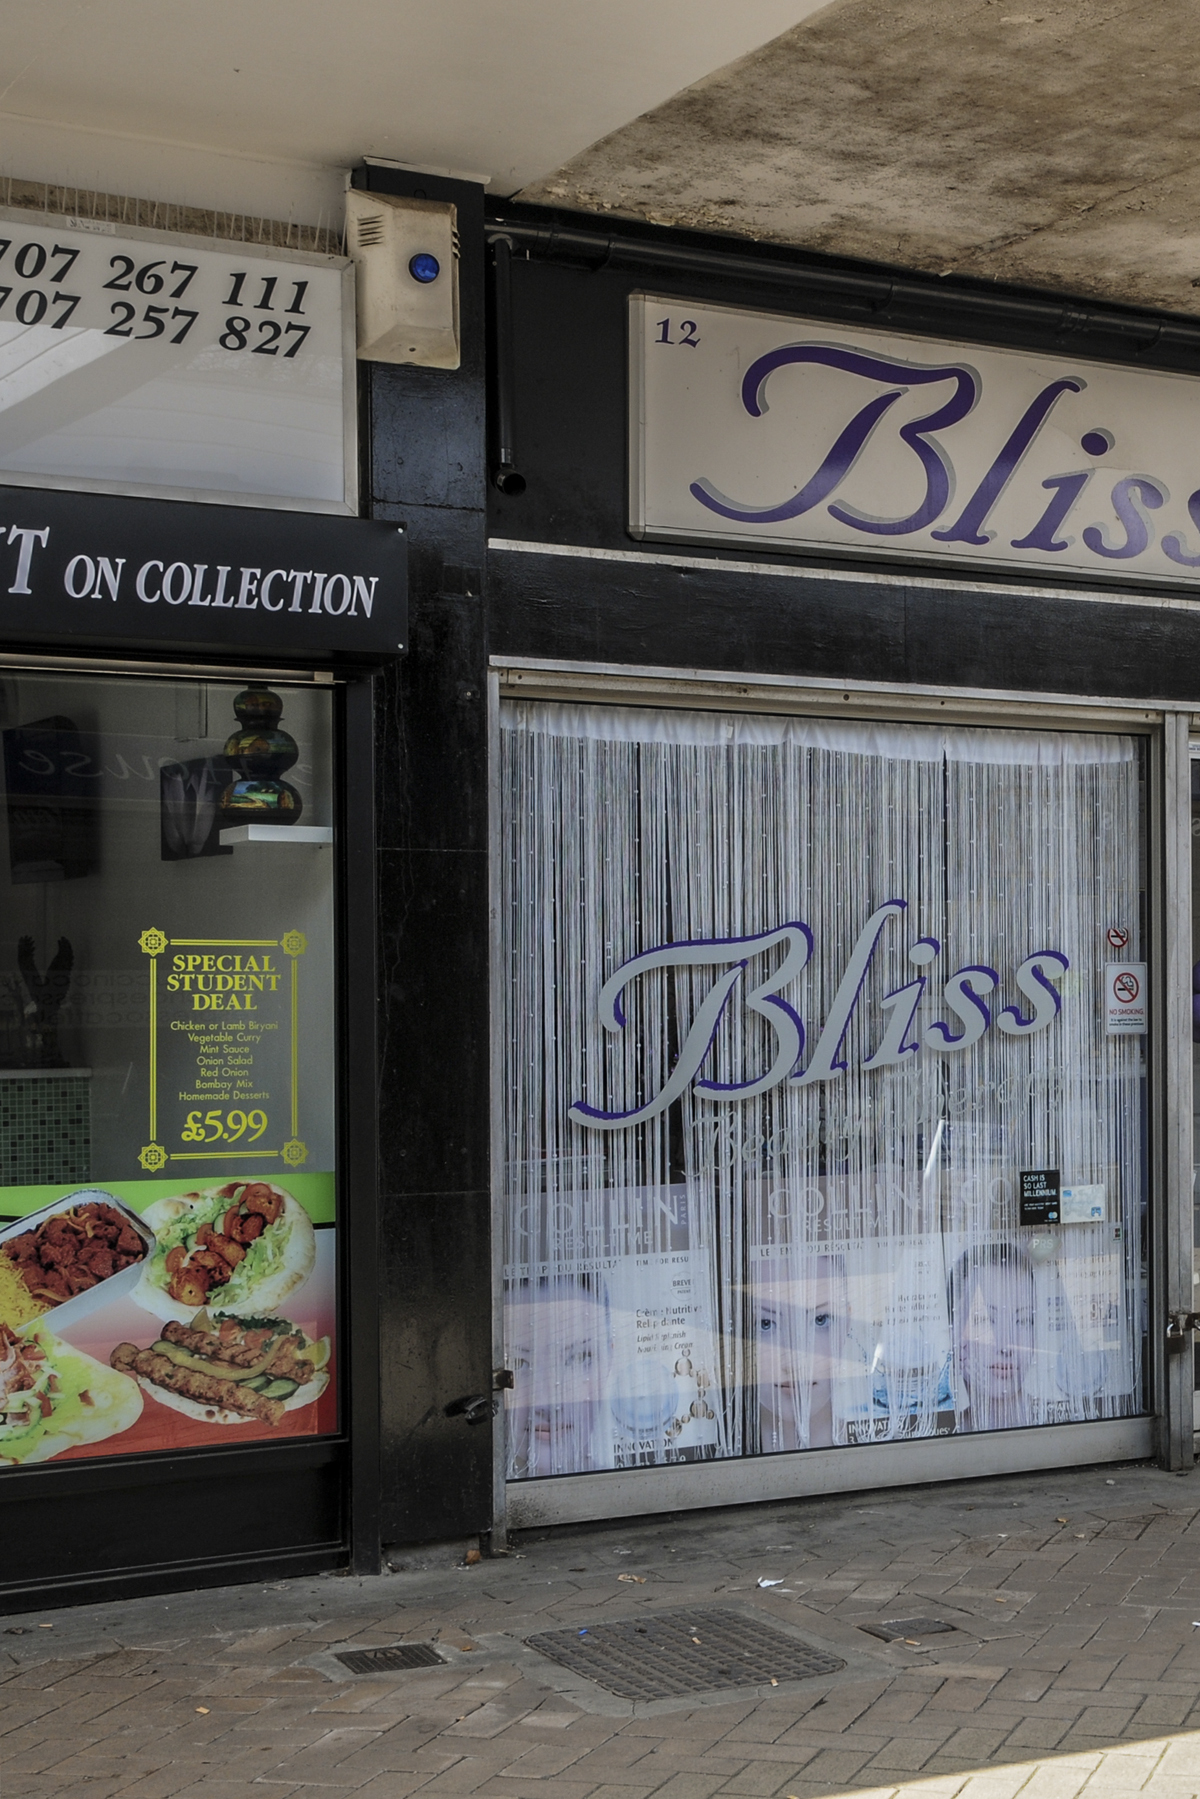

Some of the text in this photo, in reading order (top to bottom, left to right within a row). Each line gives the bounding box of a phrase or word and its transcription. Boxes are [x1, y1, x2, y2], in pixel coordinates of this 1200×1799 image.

[103, 256, 199, 299] 267
[222, 272, 310, 315] 111
[103, 301, 200, 345] 257
[218, 316, 312, 359] 827
[654, 317, 702, 349] 12
[0, 525, 380, 619] T ON COLLECTION
[172, 954, 276, 973] SPECIAL
[166, 973, 282, 992] STUDENT
[192, 993, 258, 1011] DEAL
[567, 898, 1070, 1131] Bliss
[170, 1020, 279, 1033] Chicken or Lamb Biryani
[188, 1032, 262, 1045] Vegetable Curry
[200, 1044, 250, 1054] Mint Sauce
[196, 1055, 253, 1066] Onion Salad
[200, 1067, 249, 1077] Red Onion
[195, 1079, 253, 1091] Bombay Mix
[178, 1090, 270, 1101] Homemade Desserts
[180, 1109, 269, 1143] £5.99
[1032, 1238, 1054, 1249] PRS
